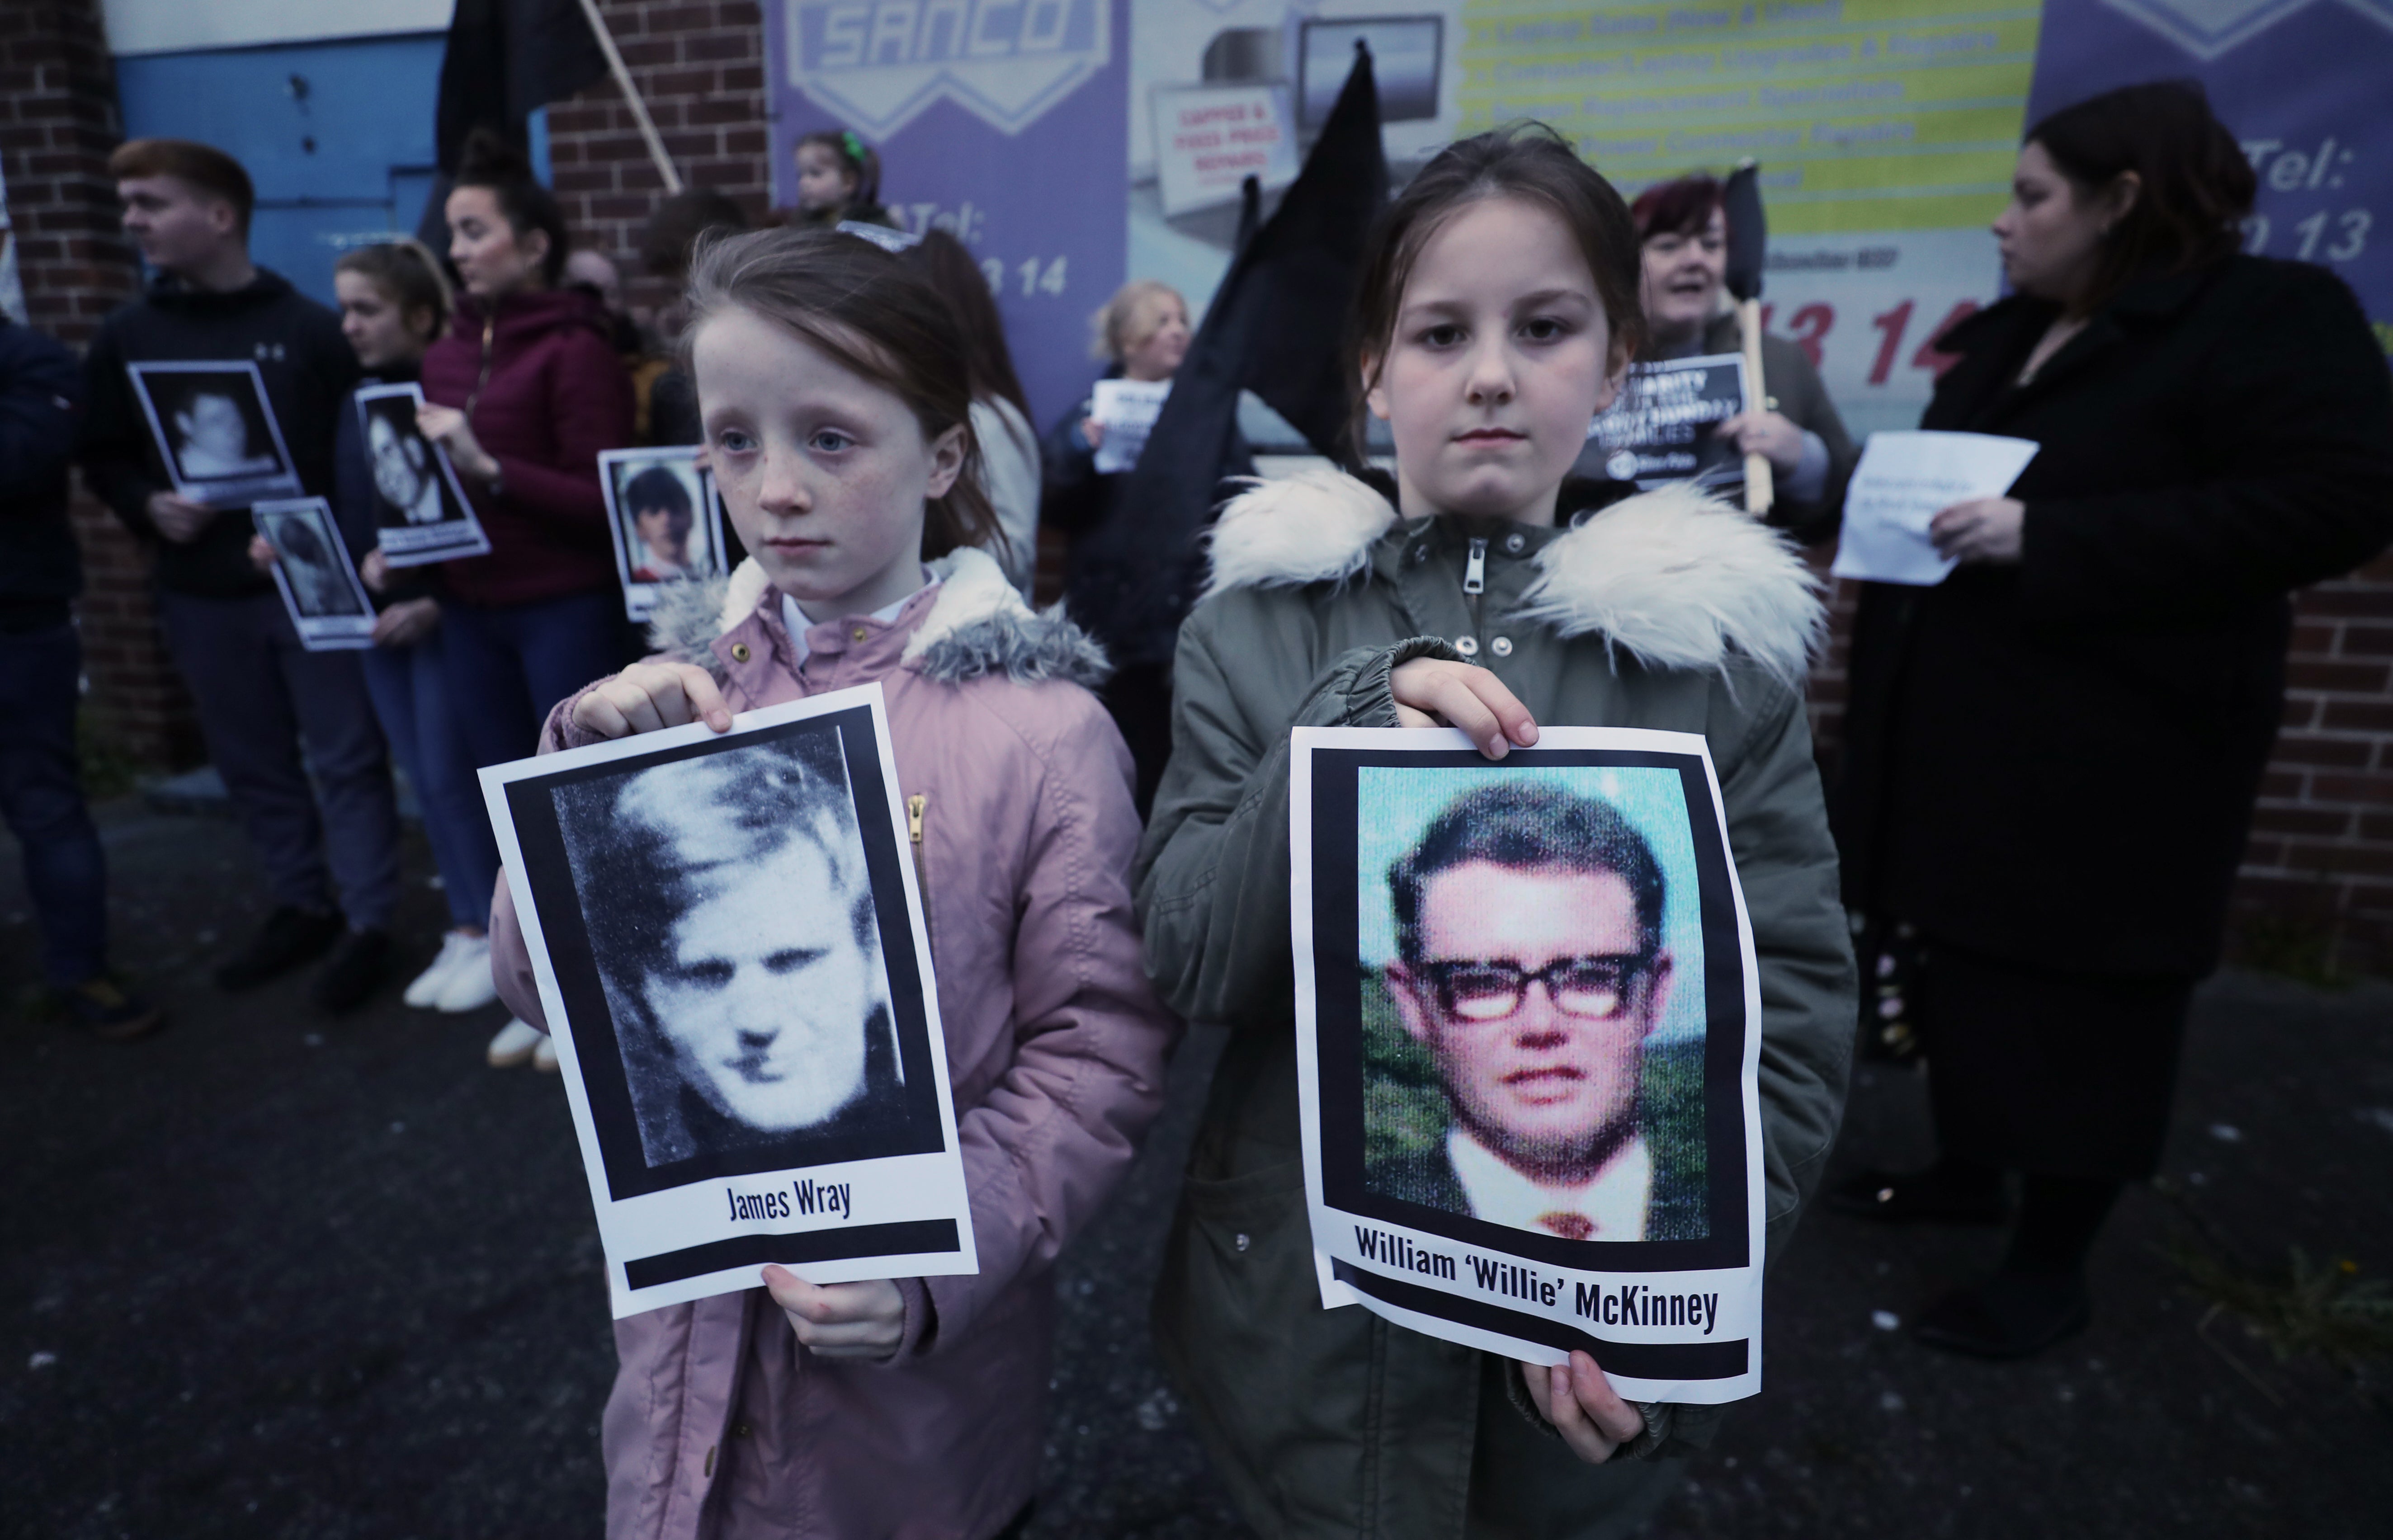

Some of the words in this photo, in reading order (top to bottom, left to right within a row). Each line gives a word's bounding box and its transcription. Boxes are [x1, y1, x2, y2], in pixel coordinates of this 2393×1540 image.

[2240, 137, 2354, 192] Tel:
[2295, 210, 2374, 261] 13
[1018, 254, 1067, 297] 14
[727, 1186, 790, 1222] James
[793, 1178, 851, 1219] Wray
[1354, 1225, 1457, 1281] William
[1575, 1282, 1719, 1335] McKinney
